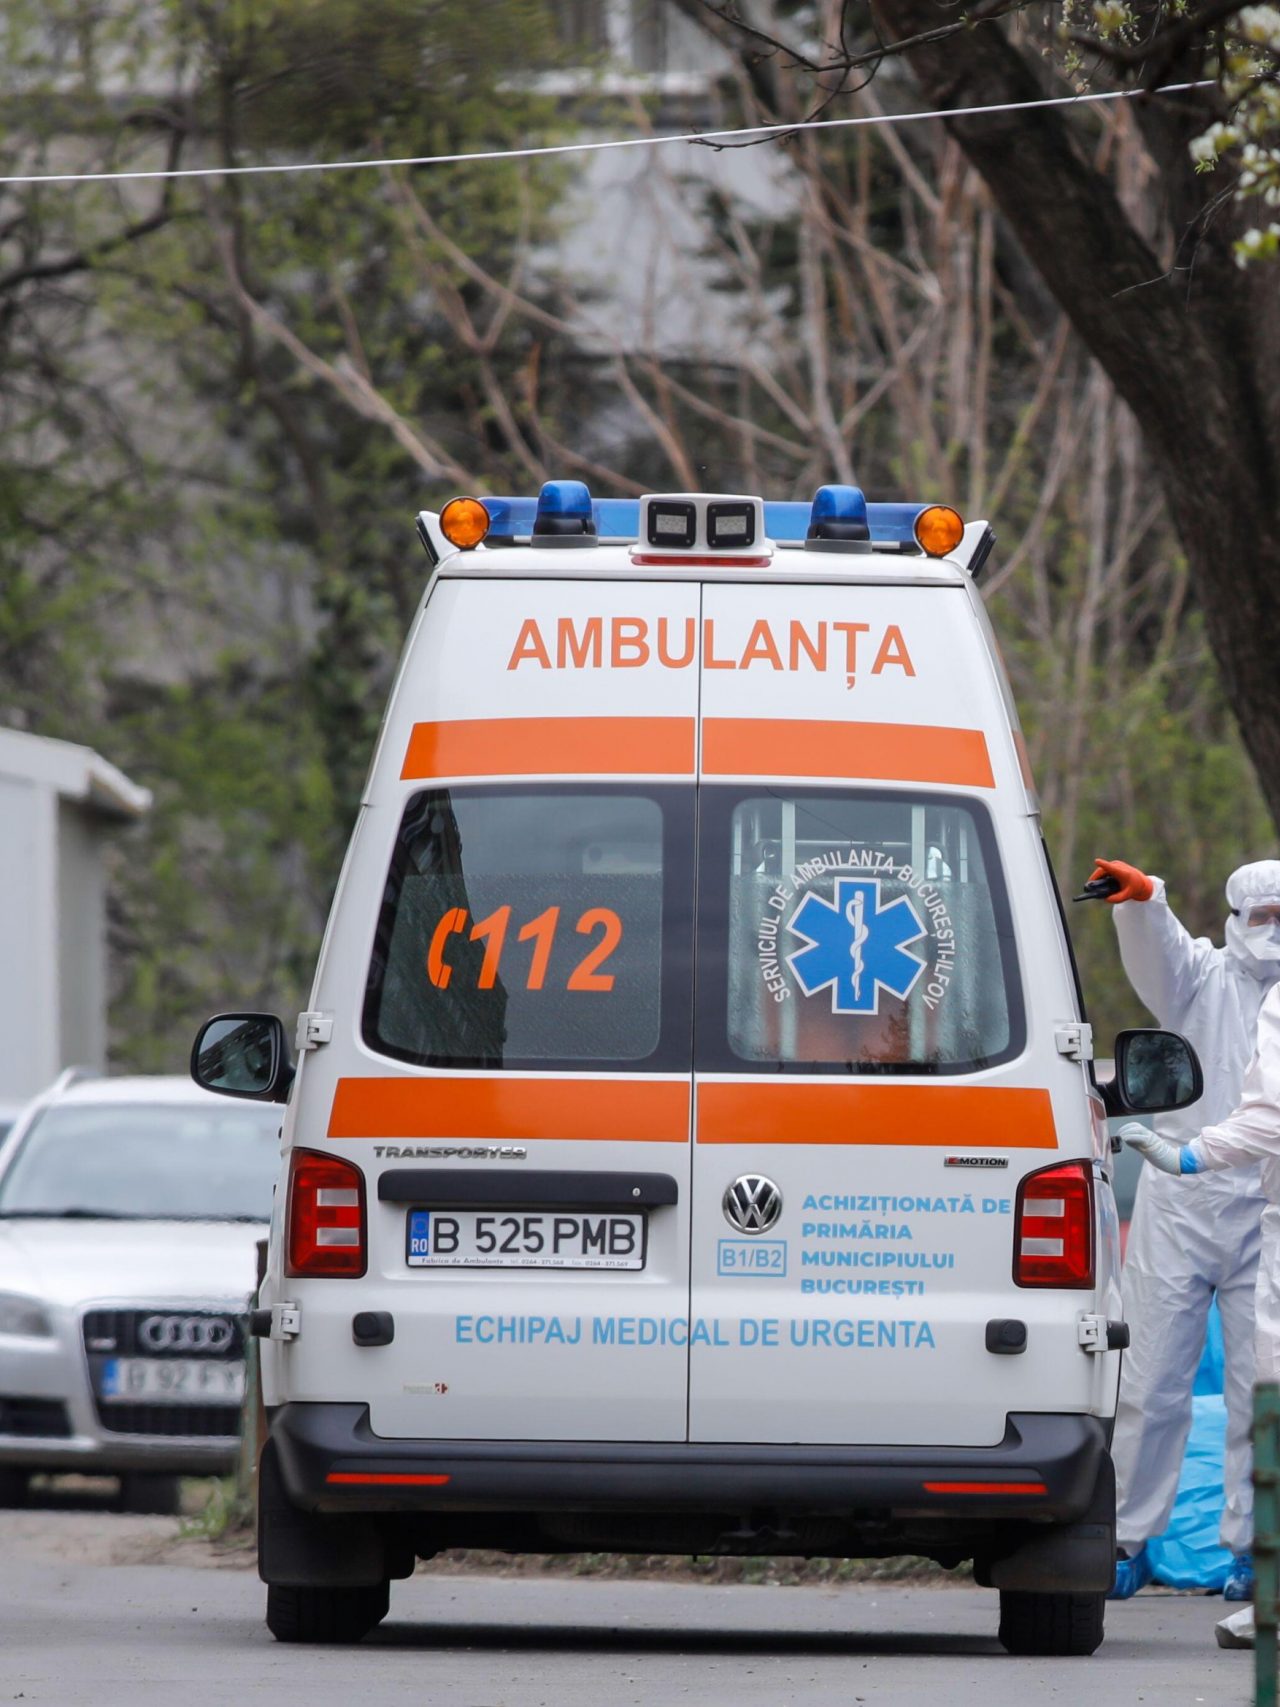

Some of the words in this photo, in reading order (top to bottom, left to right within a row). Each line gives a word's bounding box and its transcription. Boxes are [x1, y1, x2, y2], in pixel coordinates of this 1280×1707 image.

[507, 616, 916, 690] AMBULANȚA
[790, 848, 895, 891] AMBULANȚA
[768, 884, 794, 911] DE
[469, 904, 624, 992] 112
[896, 863, 956, 1011] BUCUREȘTI-ILFOV
[757, 914, 791, 1003] SERVICIUL
[372, 1145, 528, 1161] TRANSPORTER
[802, 1193, 976, 1217] ACHIZIȚIONATĂ
[981, 1198, 1011, 1215] DE
[411, 1238, 429, 1254] RO
[433, 1217, 460, 1254] B
[475, 1217, 545, 1255] 525
[553, 1217, 636, 1256] PMB
[801, 1219, 913, 1240] PRIMĂRIA
[722, 1247, 782, 1269] B1/B2
[801, 1250, 955, 1269] MUNICIPIULUI
[800, 1278, 925, 1299] BUCUREȘTI
[455, 1314, 582, 1345] ECHIPAJ
[592, 1316, 729, 1346] MEDICAL
[738, 1317, 780, 1347] DE
[789, 1318, 936, 1349] URGENTA
